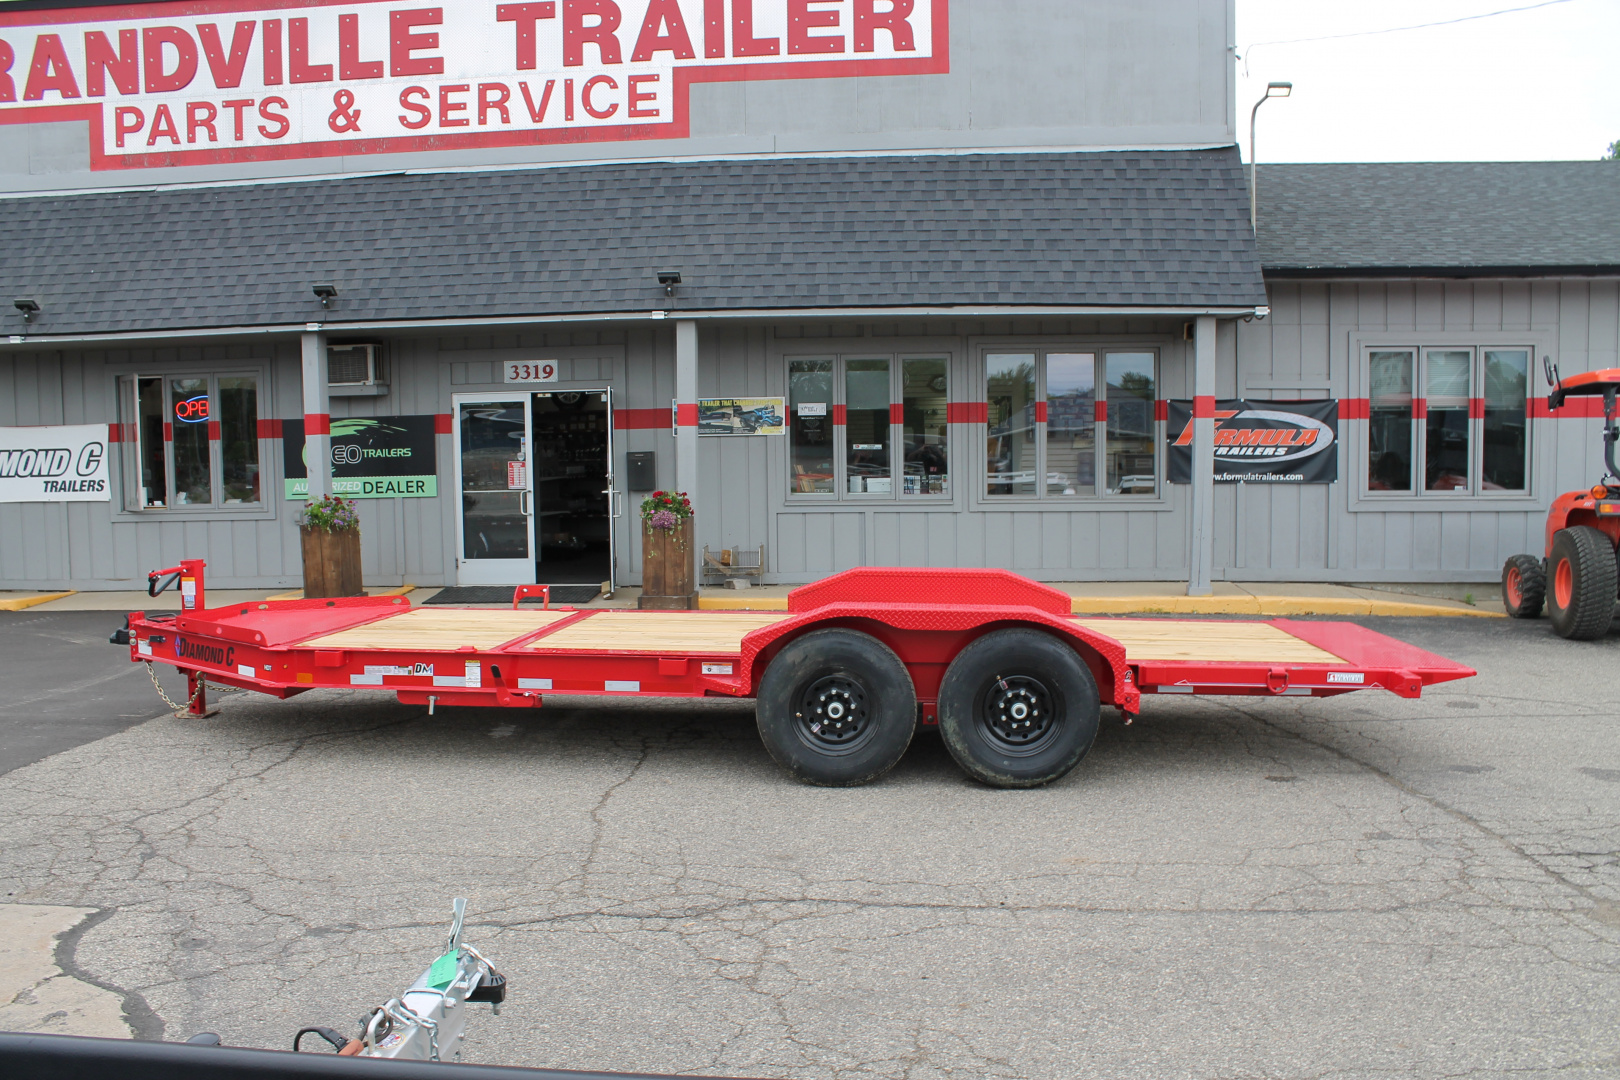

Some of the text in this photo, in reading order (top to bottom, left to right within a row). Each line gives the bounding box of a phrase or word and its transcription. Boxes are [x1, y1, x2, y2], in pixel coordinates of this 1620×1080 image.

[0, 0, 916, 102] ANDVILLE TRAILER
[115, 74, 660, 147] PARTS & SERVICE
[509, 364, 554, 380] 3319
[175, 400, 209, 417] OPE
[1171, 409, 1320, 446] FRMULA
[76, 441, 103, 477] C
[330, 444, 412, 464] EO TRAILERS
[43, 479, 105, 493] TRAILERS
[1213, 472, 1304, 482] w.formulatrailers.com
[363, 480, 425, 494] DEALER
[180, 638, 224, 664] DIAMOND
[226, 646, 235, 667] C
[415, 663, 433, 674] DM
